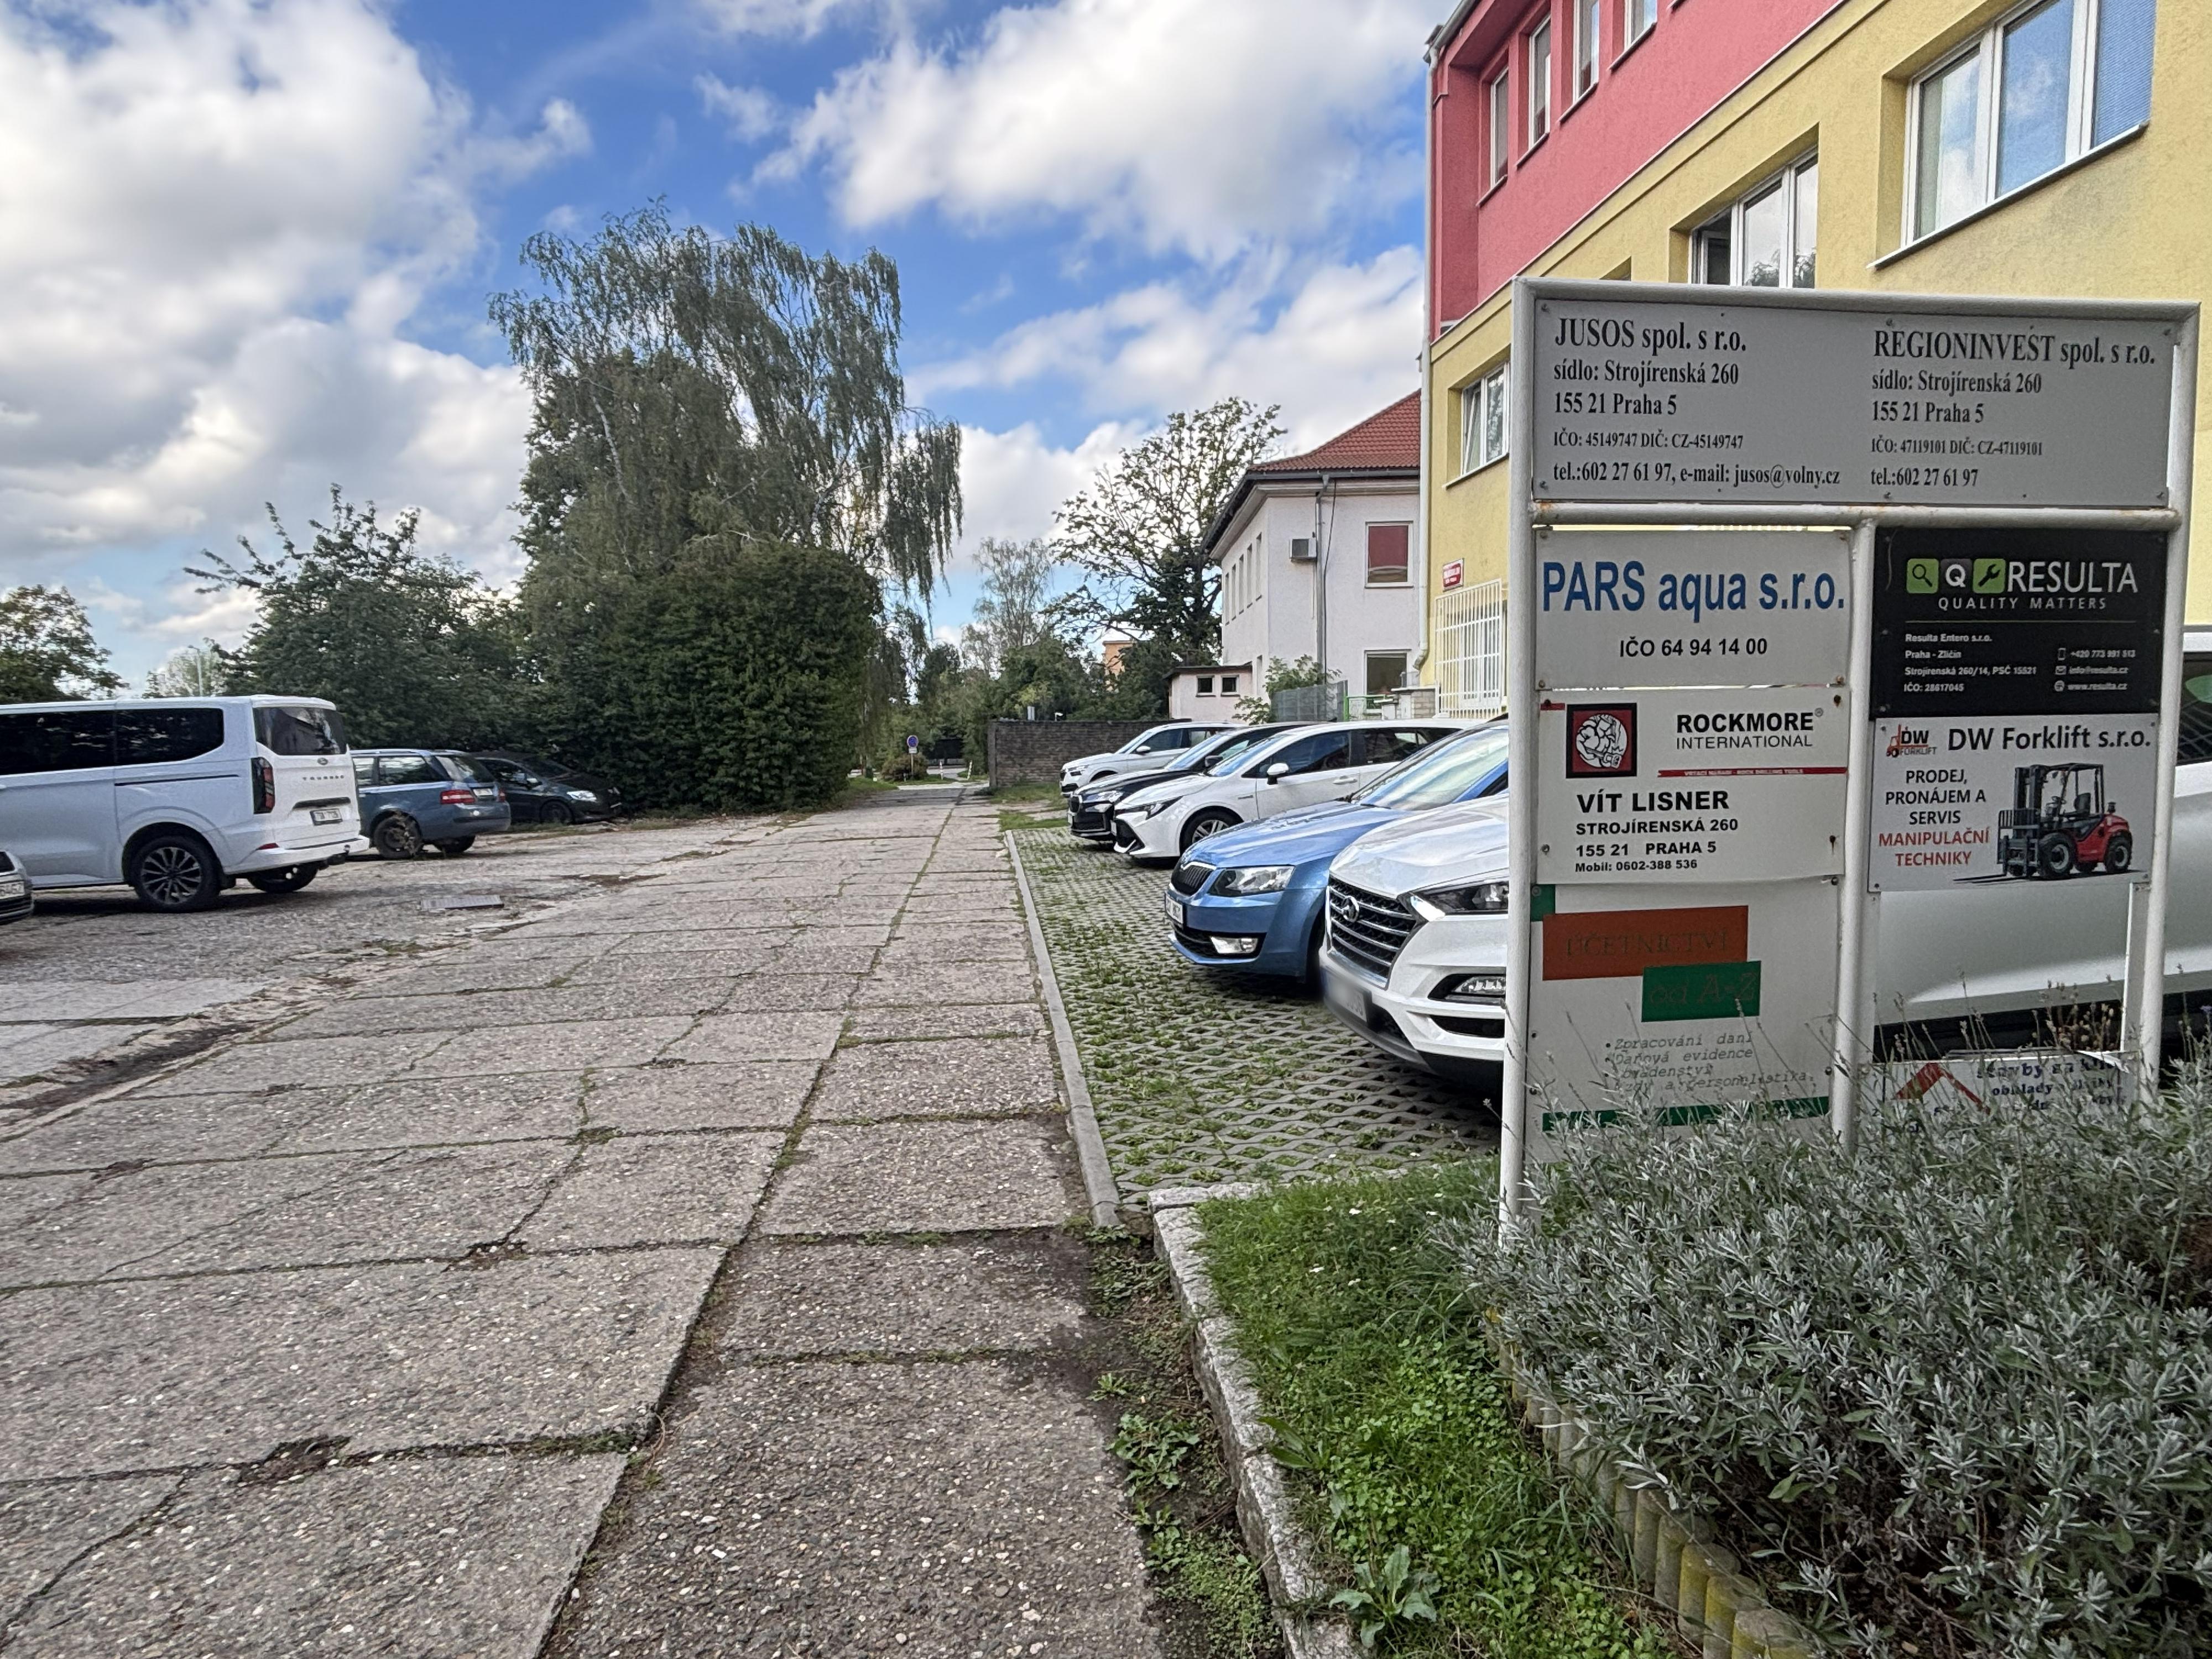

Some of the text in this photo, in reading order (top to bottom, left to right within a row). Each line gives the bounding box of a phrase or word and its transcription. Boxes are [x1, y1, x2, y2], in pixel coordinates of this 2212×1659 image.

[1555, 318, 1745, 356] JUSOS spol. s r.o.
[1874, 331, 2154, 369] REGIONINVEST spol. s r.o.
[1554, 358, 1738, 388] sídlo: Strojírenská 260
[1872, 369, 2042, 397] sídlo: Strojírenská 260
[1556, 392, 1676, 415] 155 21 Praha 5
[1873, 401, 1984, 423] 155 21 Praha 5
[1554, 427, 1743, 448] IČO: 45149747 DIČ: CZ-45149747
[1871, 435, 2042, 456] IČO: 47119101 DIČ: CZ-47119101
[1554, 462, 1839, 488] tel.:602 27 61 97, e-mail: jusos@volny.cz
[1871, 468, 1978, 487] tel.:602 27 61 97
[1945, 564, 1966, 587] Q
[2007, 561, 2138, 593] RESULTA
[1543, 561, 1844, 623] PARS aqua s.r.o.
[1938, 597, 2105, 611] QUALITY MATTERS
[1620, 637, 1767, 657] IČO 64 94 14 00
[1905, 667, 1956, 676] Strojírenská
[1992, 665, 2011, 674] PSČ
[1904, 682, 1923, 692] IČO:
[1677, 712, 1813, 733] ROCKMORE
[1677, 734, 1813, 749] INTERNATIONAL
[1901, 730, 1929, 744] DW
[1948, 725, 2150, 750] DW Forklift s.r.o.
[1906, 769, 1967, 784] PRODEJ,
[1577, 789, 1729, 813] VÍT LISNER
[1886, 787, 1986, 805] PRONÁJEM A
[1576, 817, 1738, 835] STROJÍRENSKÁ 260
[1910, 810, 1960, 825] SERVIS
[1879, 827, 1990, 847] MANIPULAČNÍ
[1577, 841, 1716, 857] 155 21 PRAHA 5
[1895, 851, 1971, 866] TECHNIKY
[1575, 859, 1697, 872] Mobil: 0602-388 536
[1615, 1035, 1703, 1050] Zpracování
[1683, 1048, 1753, 1062] evidence
